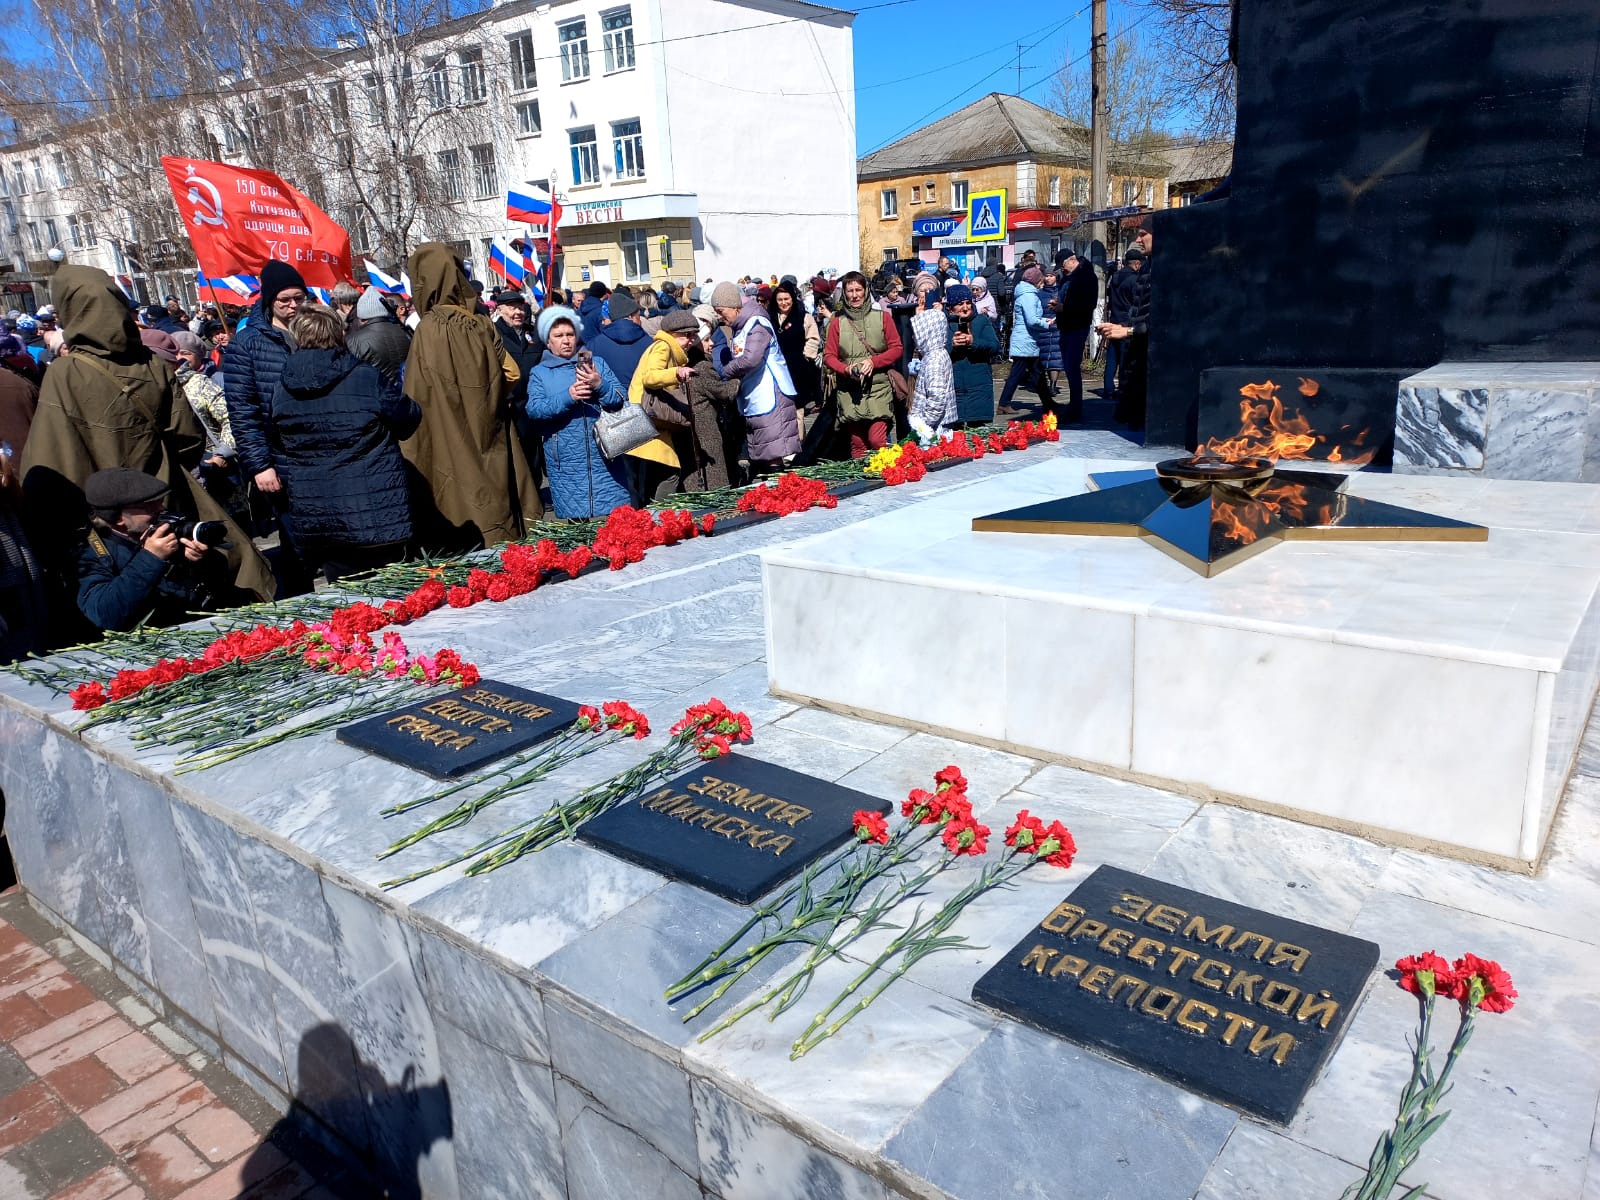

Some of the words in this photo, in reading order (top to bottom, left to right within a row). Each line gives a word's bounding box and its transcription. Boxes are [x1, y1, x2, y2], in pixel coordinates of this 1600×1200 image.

[236, 179, 256, 195] 150
[576, 208, 623, 224] ВЕСТИ
[922, 220, 957, 233] СПОРТ
[265, 239, 289, 262] 79
[461, 689, 553, 721] ЗЕМЛЯ
[386, 714, 476, 751] ГРАДА
[687, 775, 813, 827] ЗЕМЛЯ
[639, 788, 796, 856] МИНСКА
[1110, 893, 1312, 973] ЗЕМЛЯ
[1040, 902, 1340, 1029] БРЕСТСКОЙ
[1019, 944, 1296, 1066] КРЕПОСТИ
